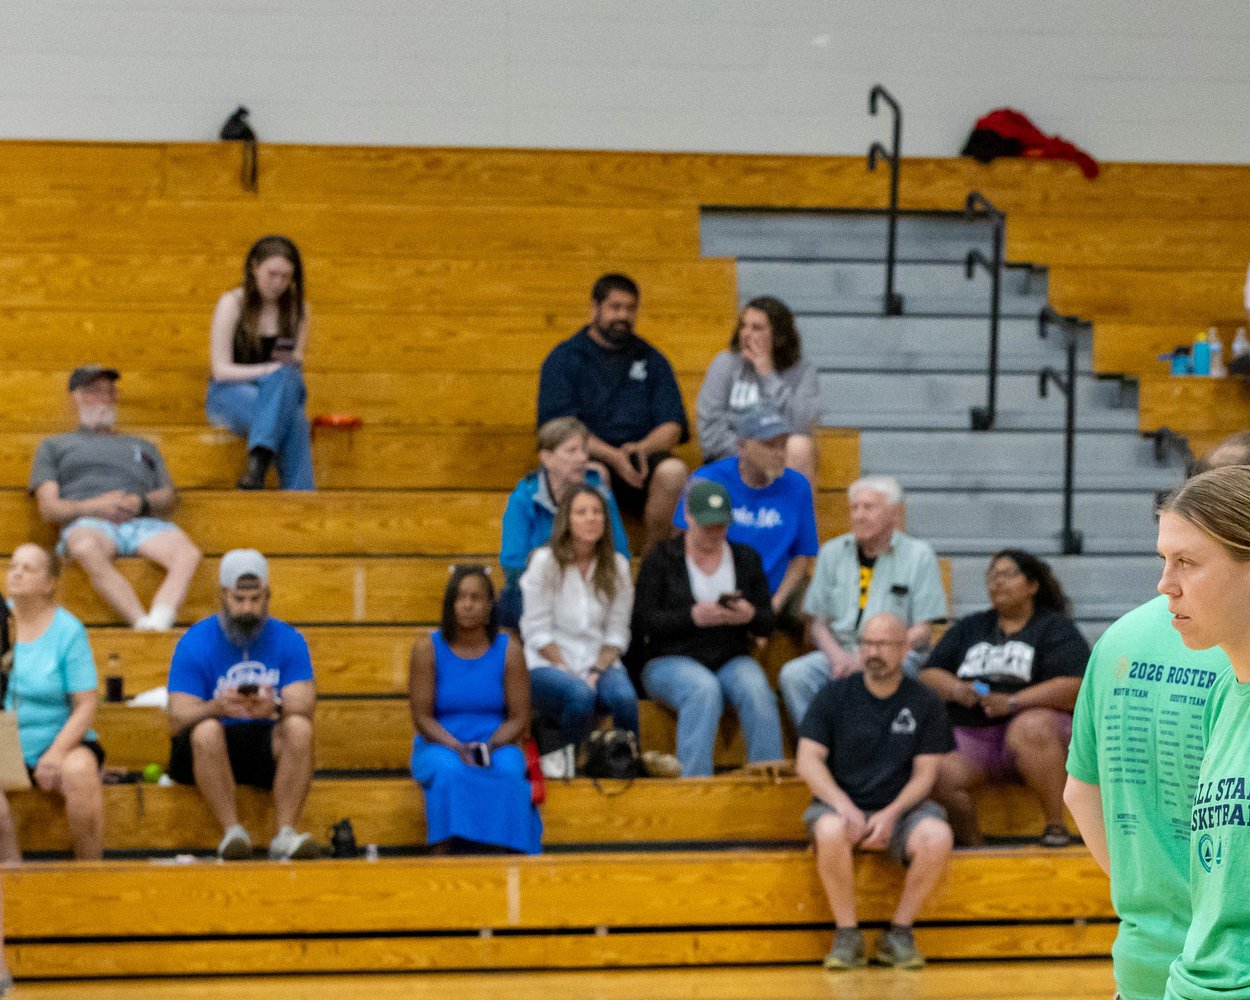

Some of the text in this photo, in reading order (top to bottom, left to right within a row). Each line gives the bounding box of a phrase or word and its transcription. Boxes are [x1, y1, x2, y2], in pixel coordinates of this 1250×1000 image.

[1129, 661, 1217, 689] 2026 ROSTER
[1131, 689, 1149, 699] TEAM
[1189, 696, 1207, 707] TEAM
